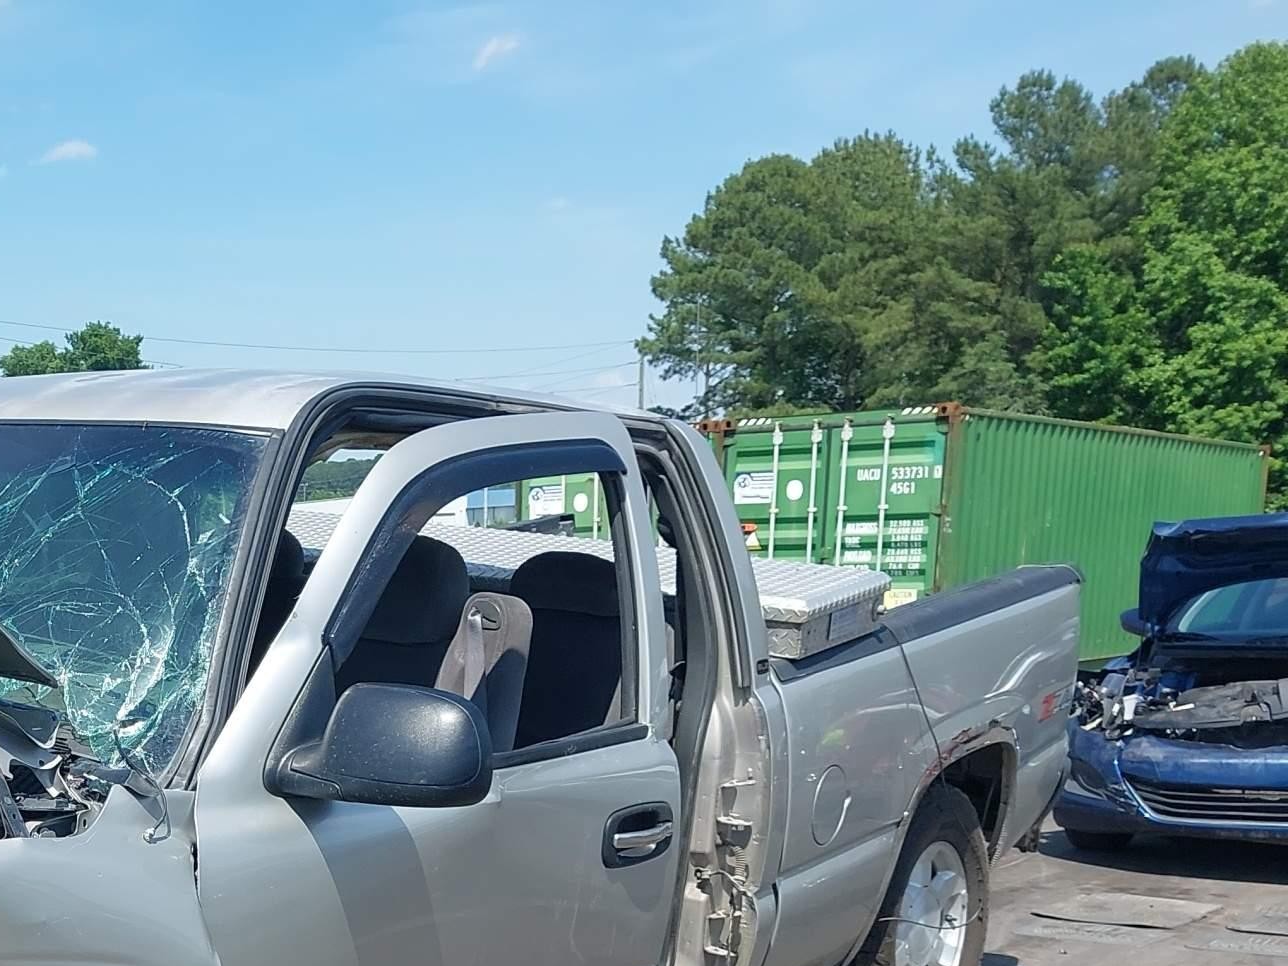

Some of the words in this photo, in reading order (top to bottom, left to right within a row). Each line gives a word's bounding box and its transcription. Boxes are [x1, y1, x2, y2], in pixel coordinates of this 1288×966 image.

[857, 468, 881, 481] UACU
[891, 466, 929, 480] 533731
[890, 481, 916, 494] 45G1
